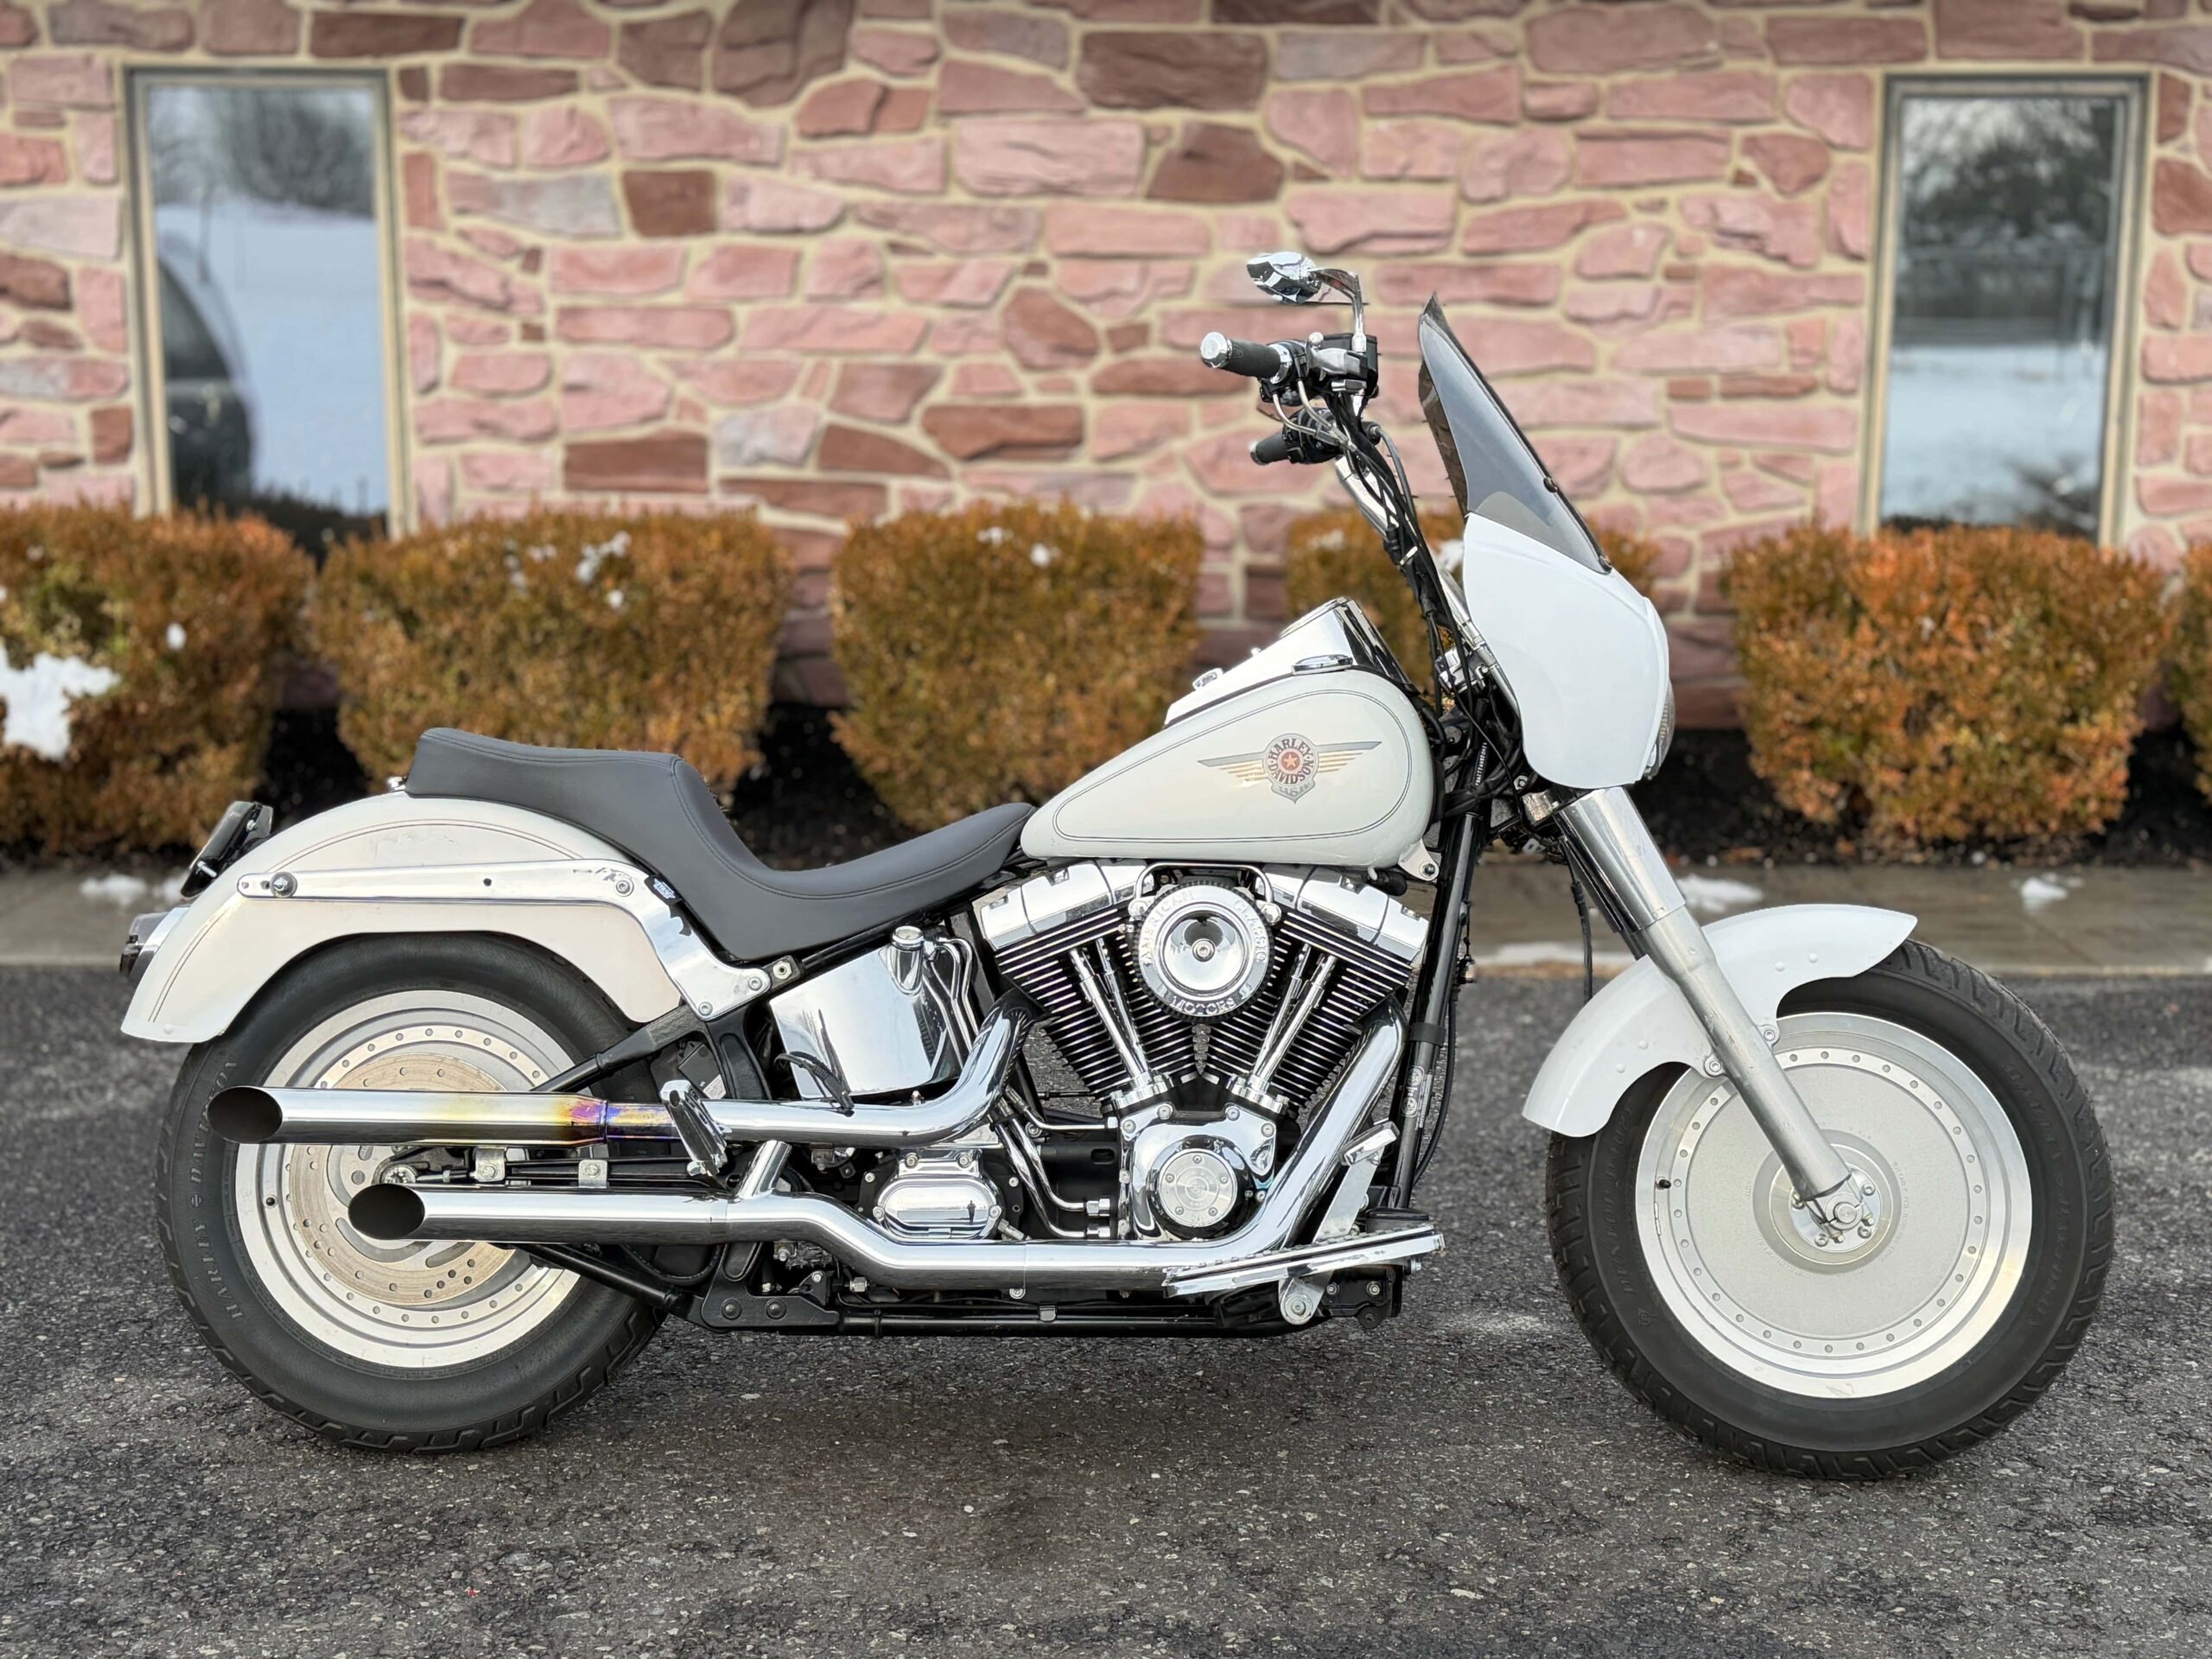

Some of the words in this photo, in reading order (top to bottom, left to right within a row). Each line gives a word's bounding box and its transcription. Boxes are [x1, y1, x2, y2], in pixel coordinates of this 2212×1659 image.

[1268, 739, 1313, 761] HARLEY
[1268, 759, 1314, 785] DAVIDSON
[1169, 997, 1237, 1016] MOTORS
[191, 1217, 244, 1319] HARLEY
